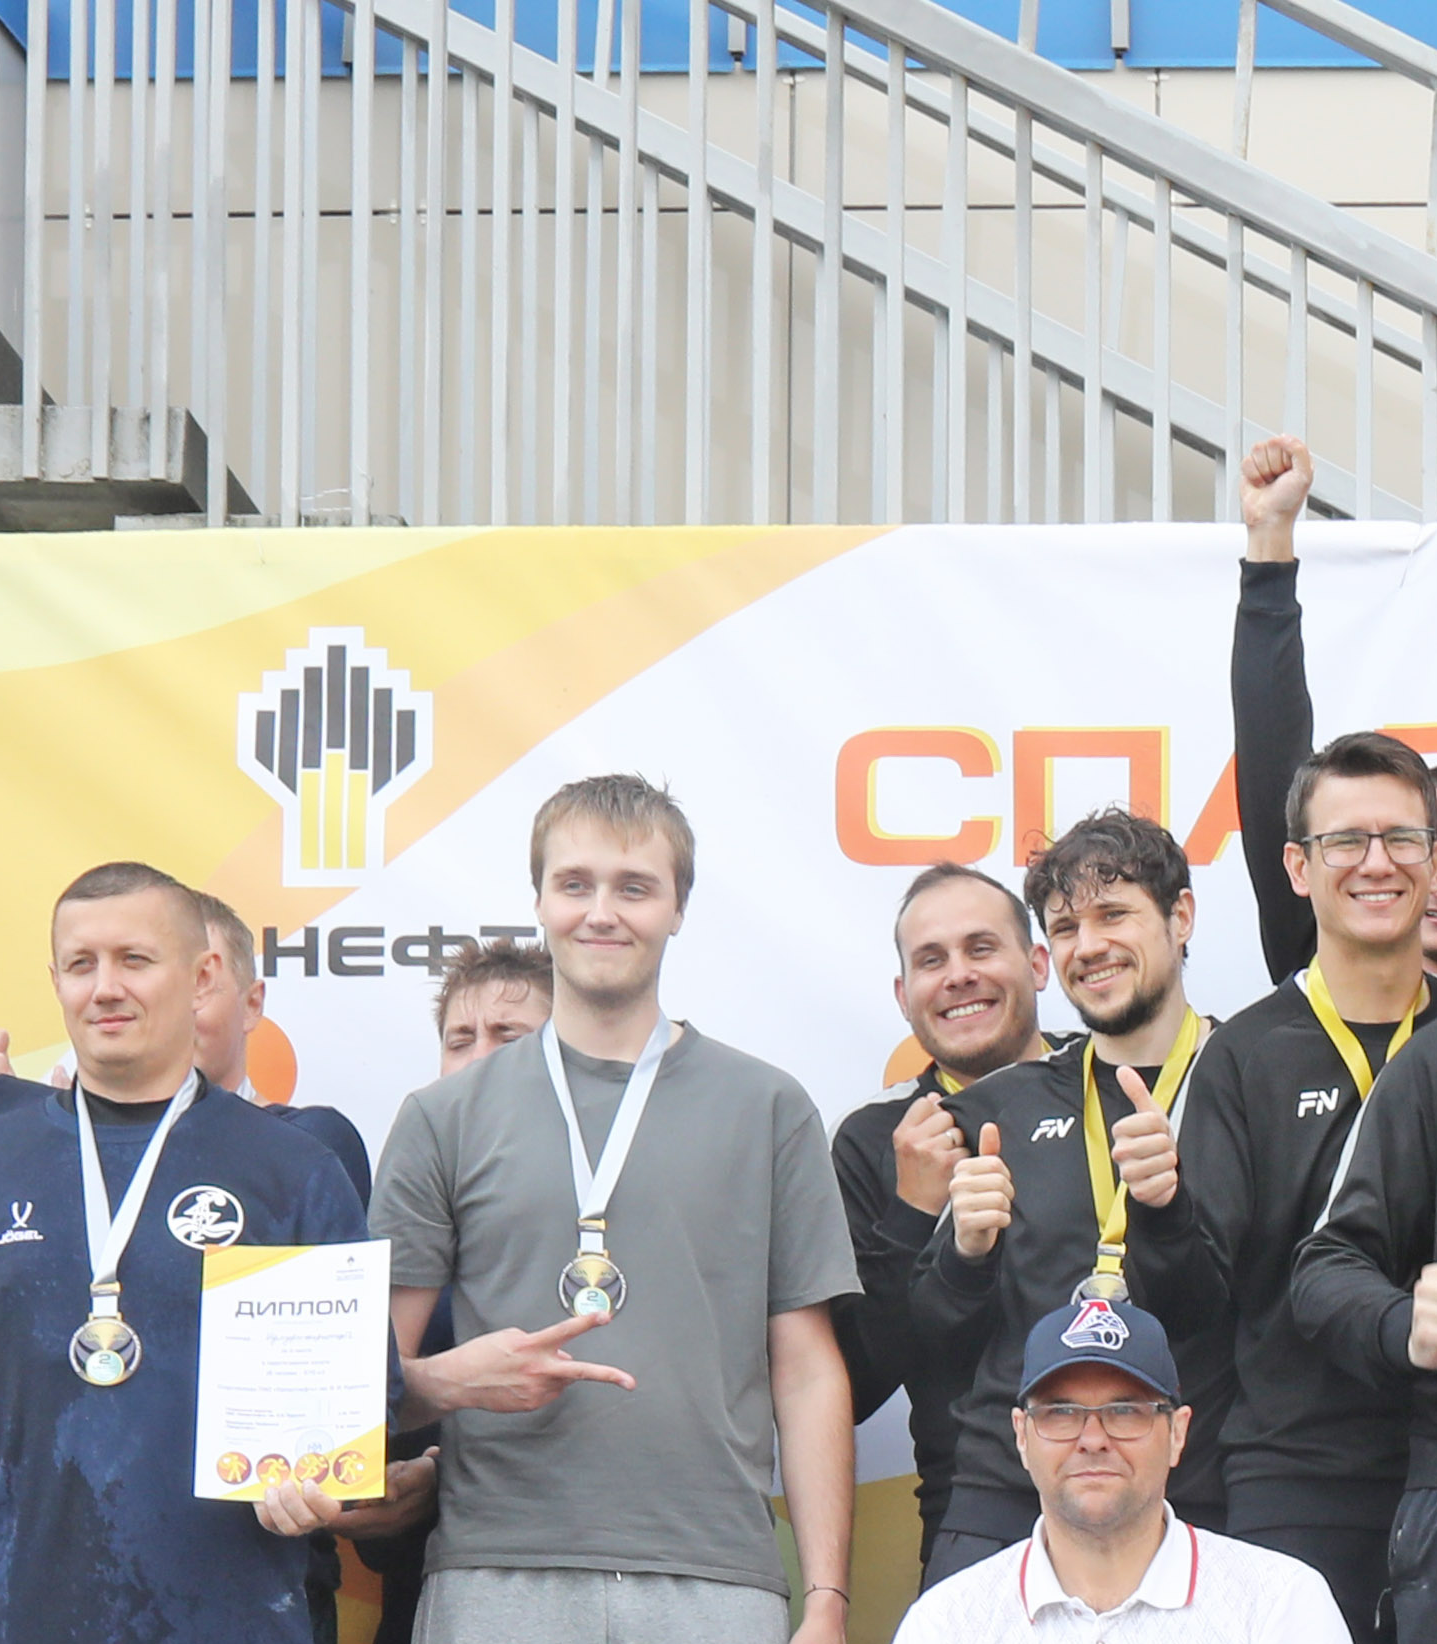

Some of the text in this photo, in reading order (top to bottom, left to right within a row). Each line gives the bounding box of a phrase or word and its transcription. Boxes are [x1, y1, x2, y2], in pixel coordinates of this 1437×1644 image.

[261, 925, 538, 978] НЕФТ
[1297, 1087, 1340, 1119] FN
[1030, 1116, 1076, 1143] FN
[235, 1299, 359, 1319] ДИПЛОМ
